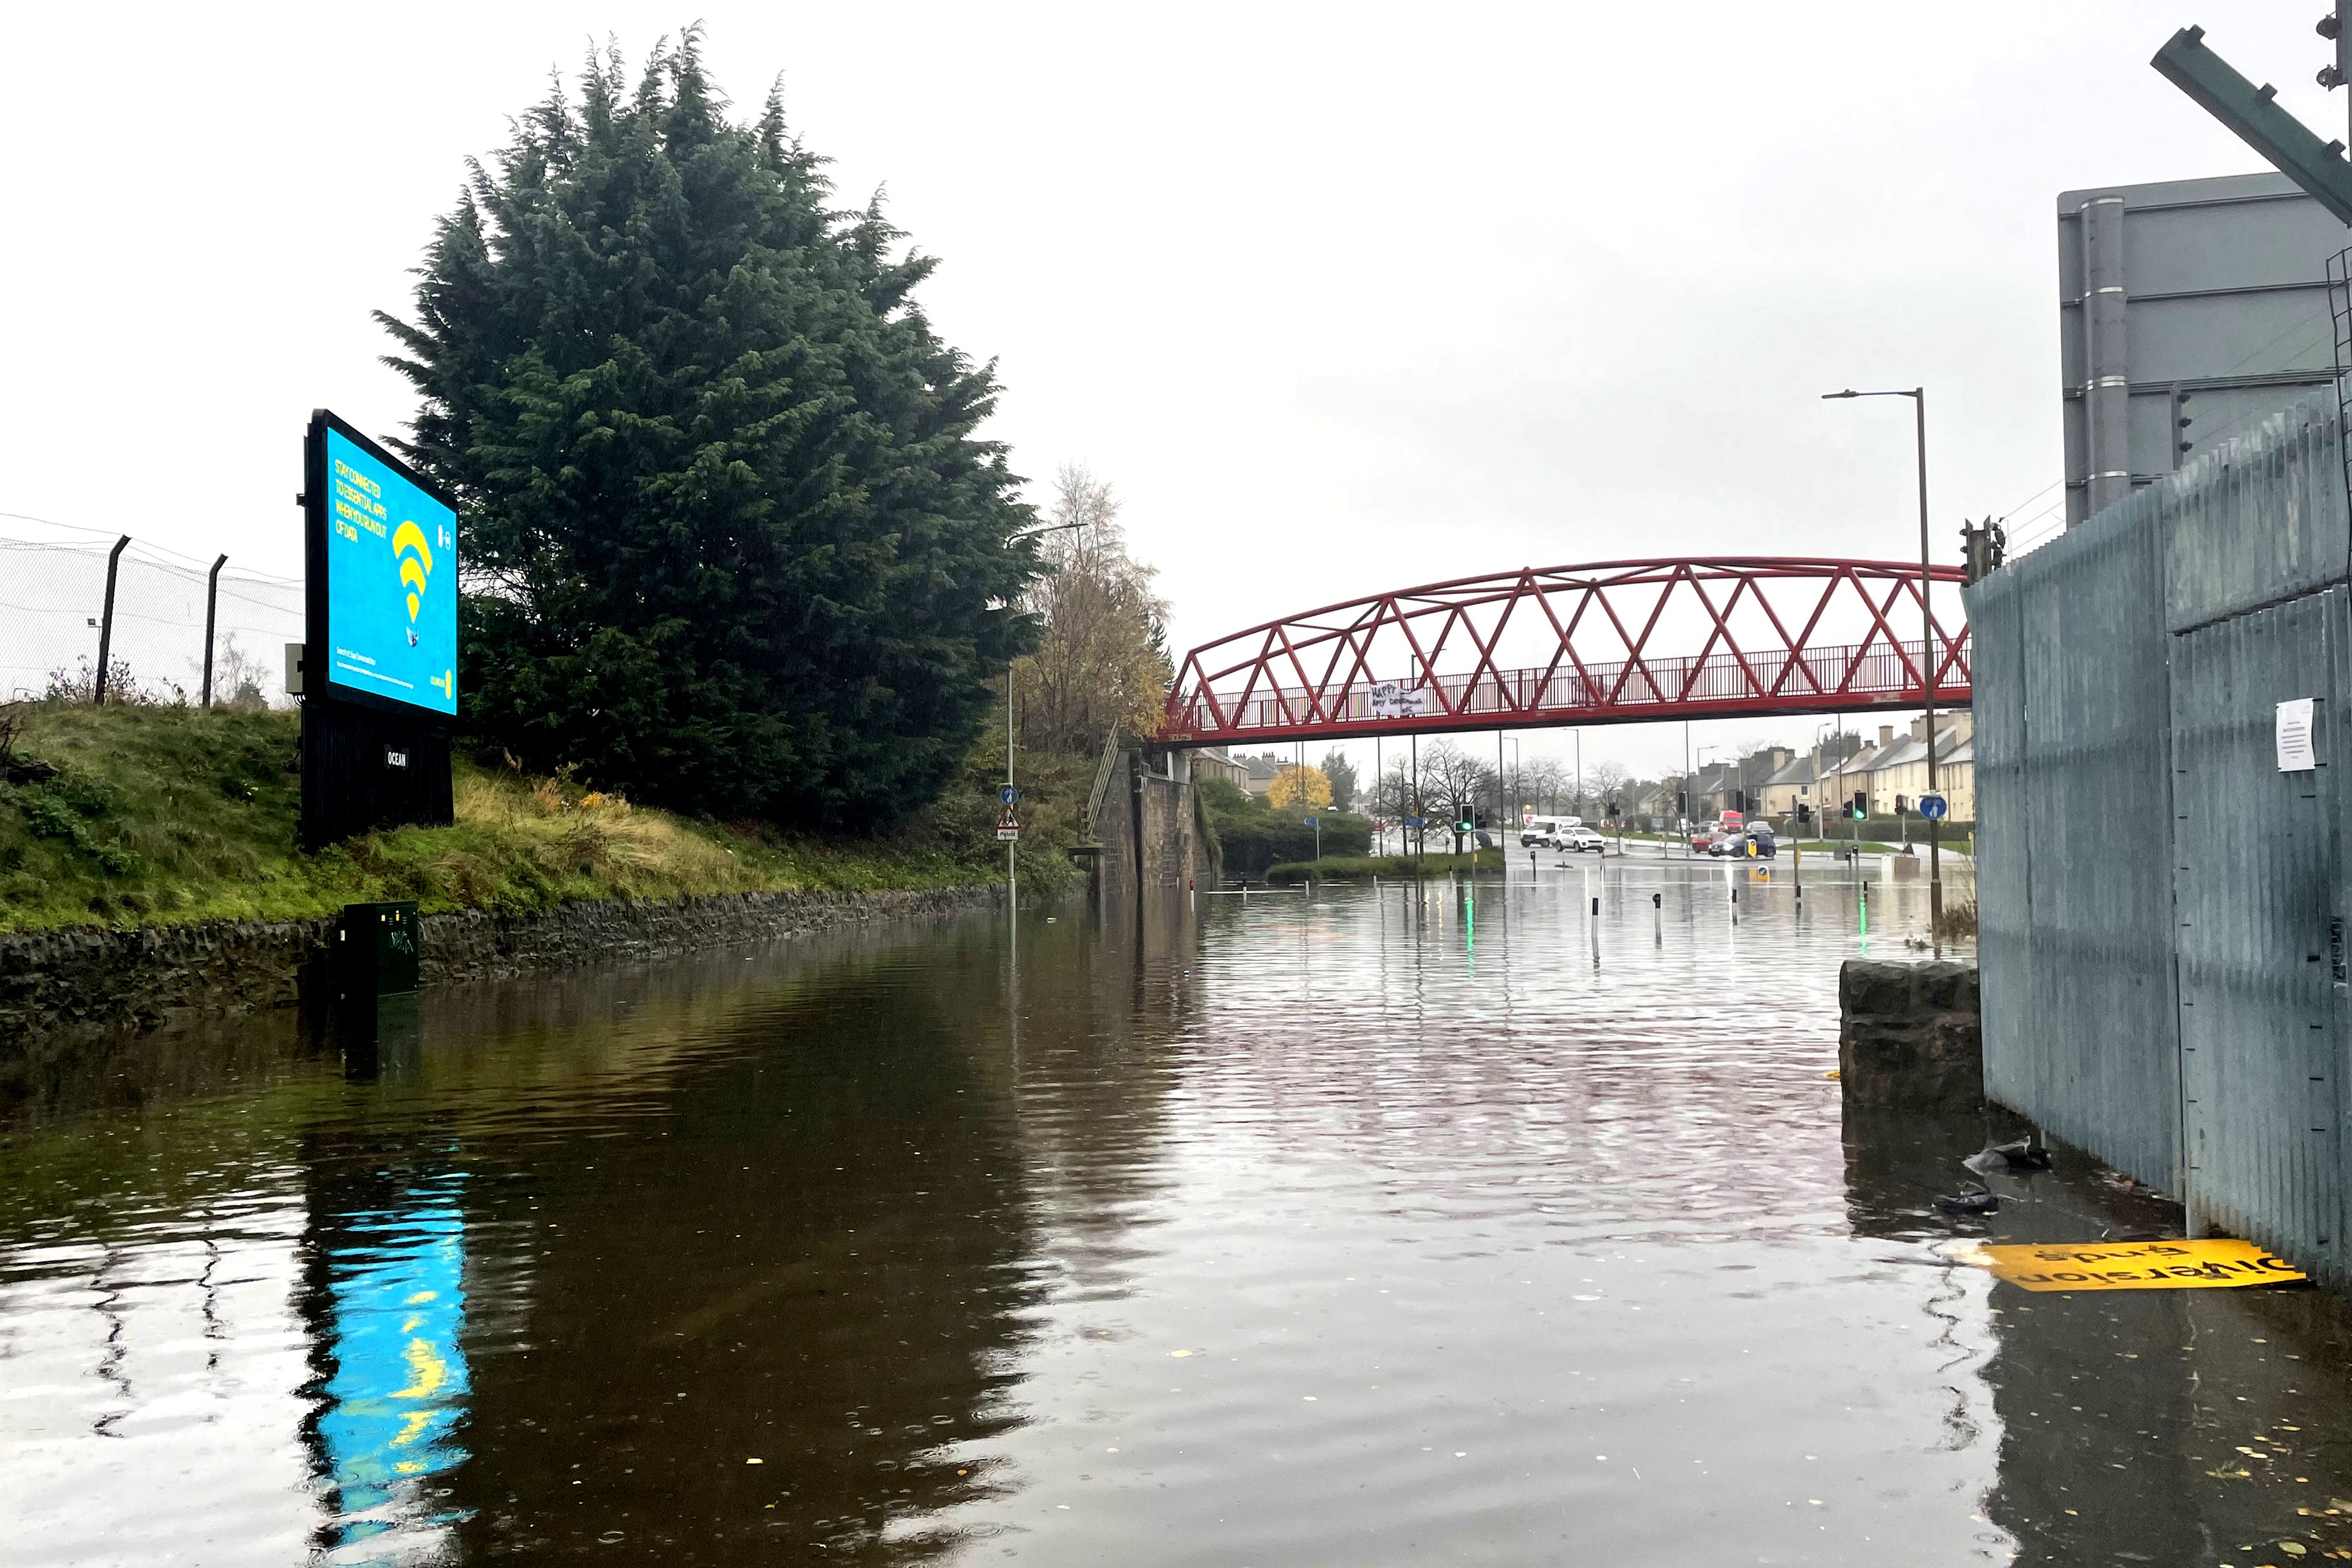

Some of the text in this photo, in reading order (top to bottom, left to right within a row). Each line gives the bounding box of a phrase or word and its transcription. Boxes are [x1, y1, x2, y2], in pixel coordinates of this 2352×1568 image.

[335, 479, 344, 496] TO
[344, 483, 373, 514] ESSENTIAL
[349, 468, 380, 499] CONNECTED
[335, 499, 387, 539] WHEN YOU RUN OUT
[1371, 684, 1396, 697] HAPPY
[388, 751, 406, 766] OCEAN
[2035, 1245, 2190, 1264] Ends
[2017, 1257, 2294, 1283] Diversion
